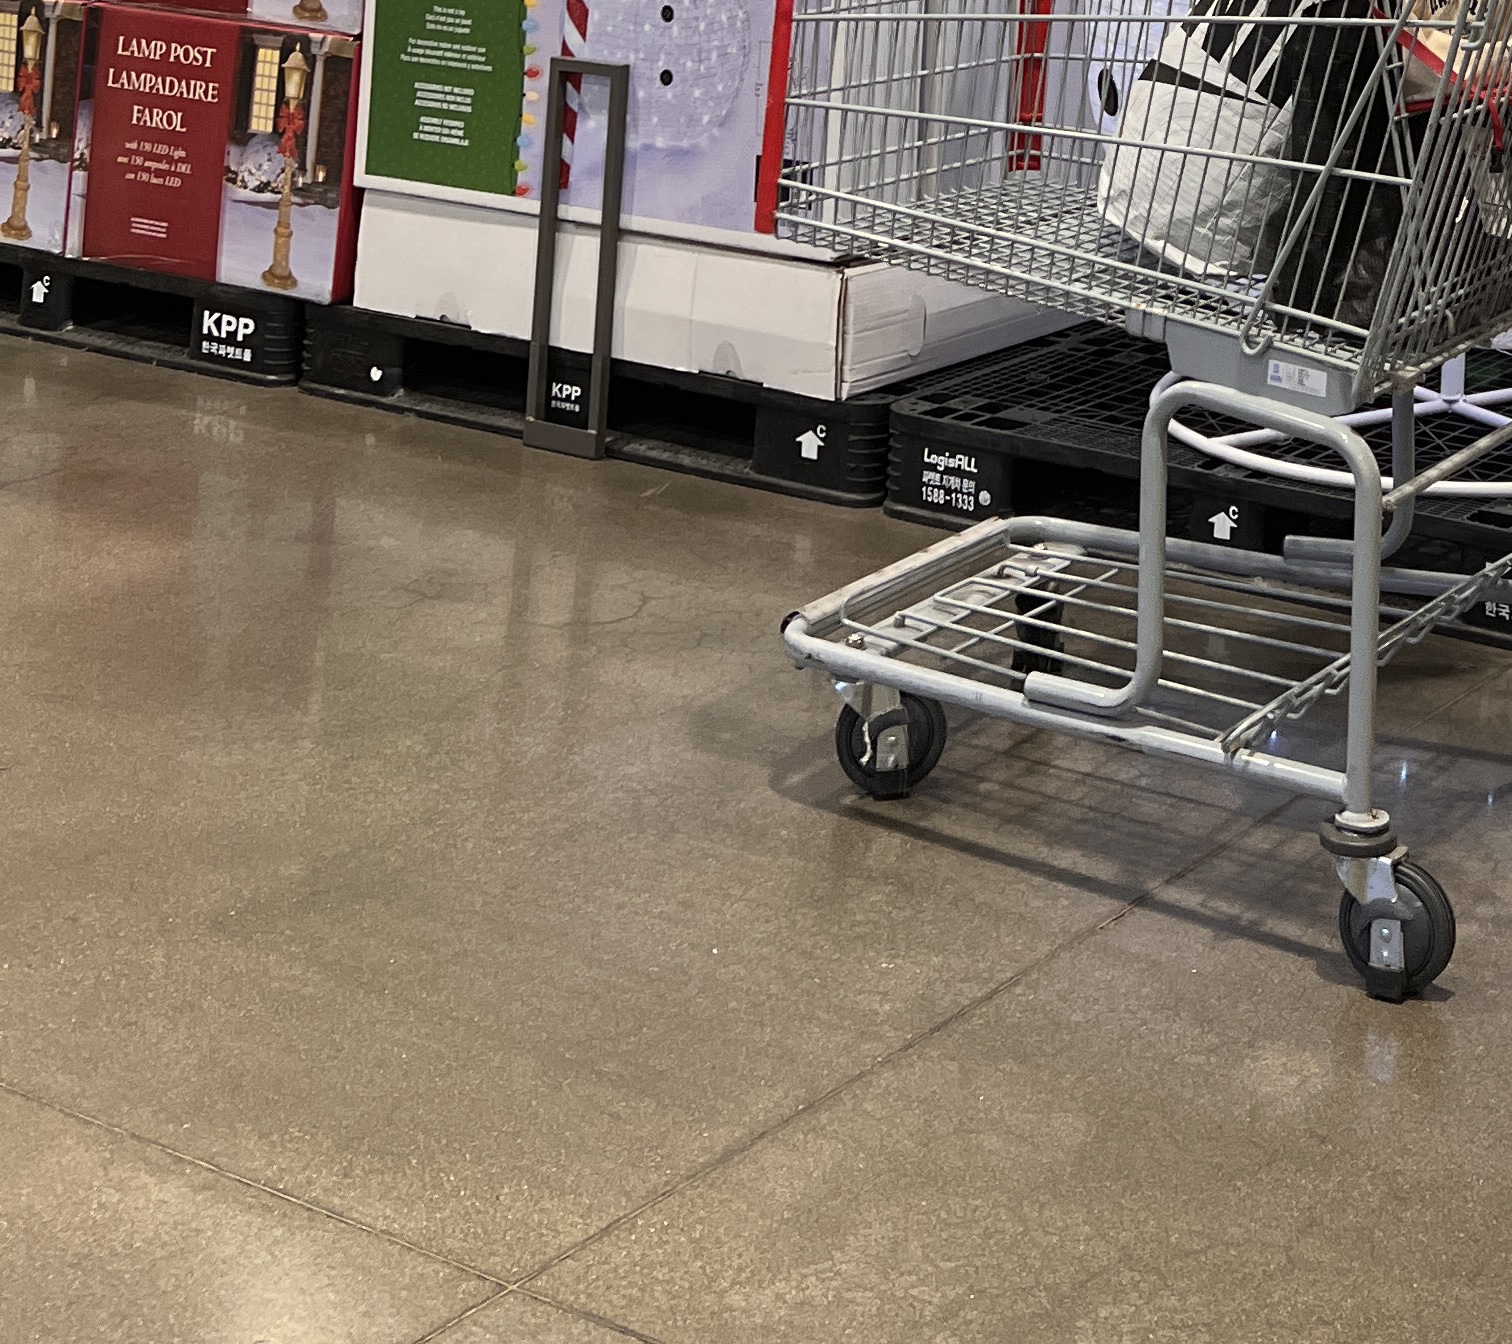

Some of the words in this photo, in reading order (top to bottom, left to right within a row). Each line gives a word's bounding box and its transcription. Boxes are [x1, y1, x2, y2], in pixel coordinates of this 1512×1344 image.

[117, 35, 167, 60] LAMP
[169, 42, 216, 68] POST
[107, 68, 219, 103] LAMPADAIRE
[131, 105, 187, 132] FAROL
[43, 276, 50, 287] C
[202, 310, 255, 342] KPP
[552, 382, 582, 401] KPP
[816, 425, 826, 438] C
[924, 448, 978, 472] LogisALL
[922, 486, 974, 511] 1588-1333
[1229, 506, 1239, 520] C
